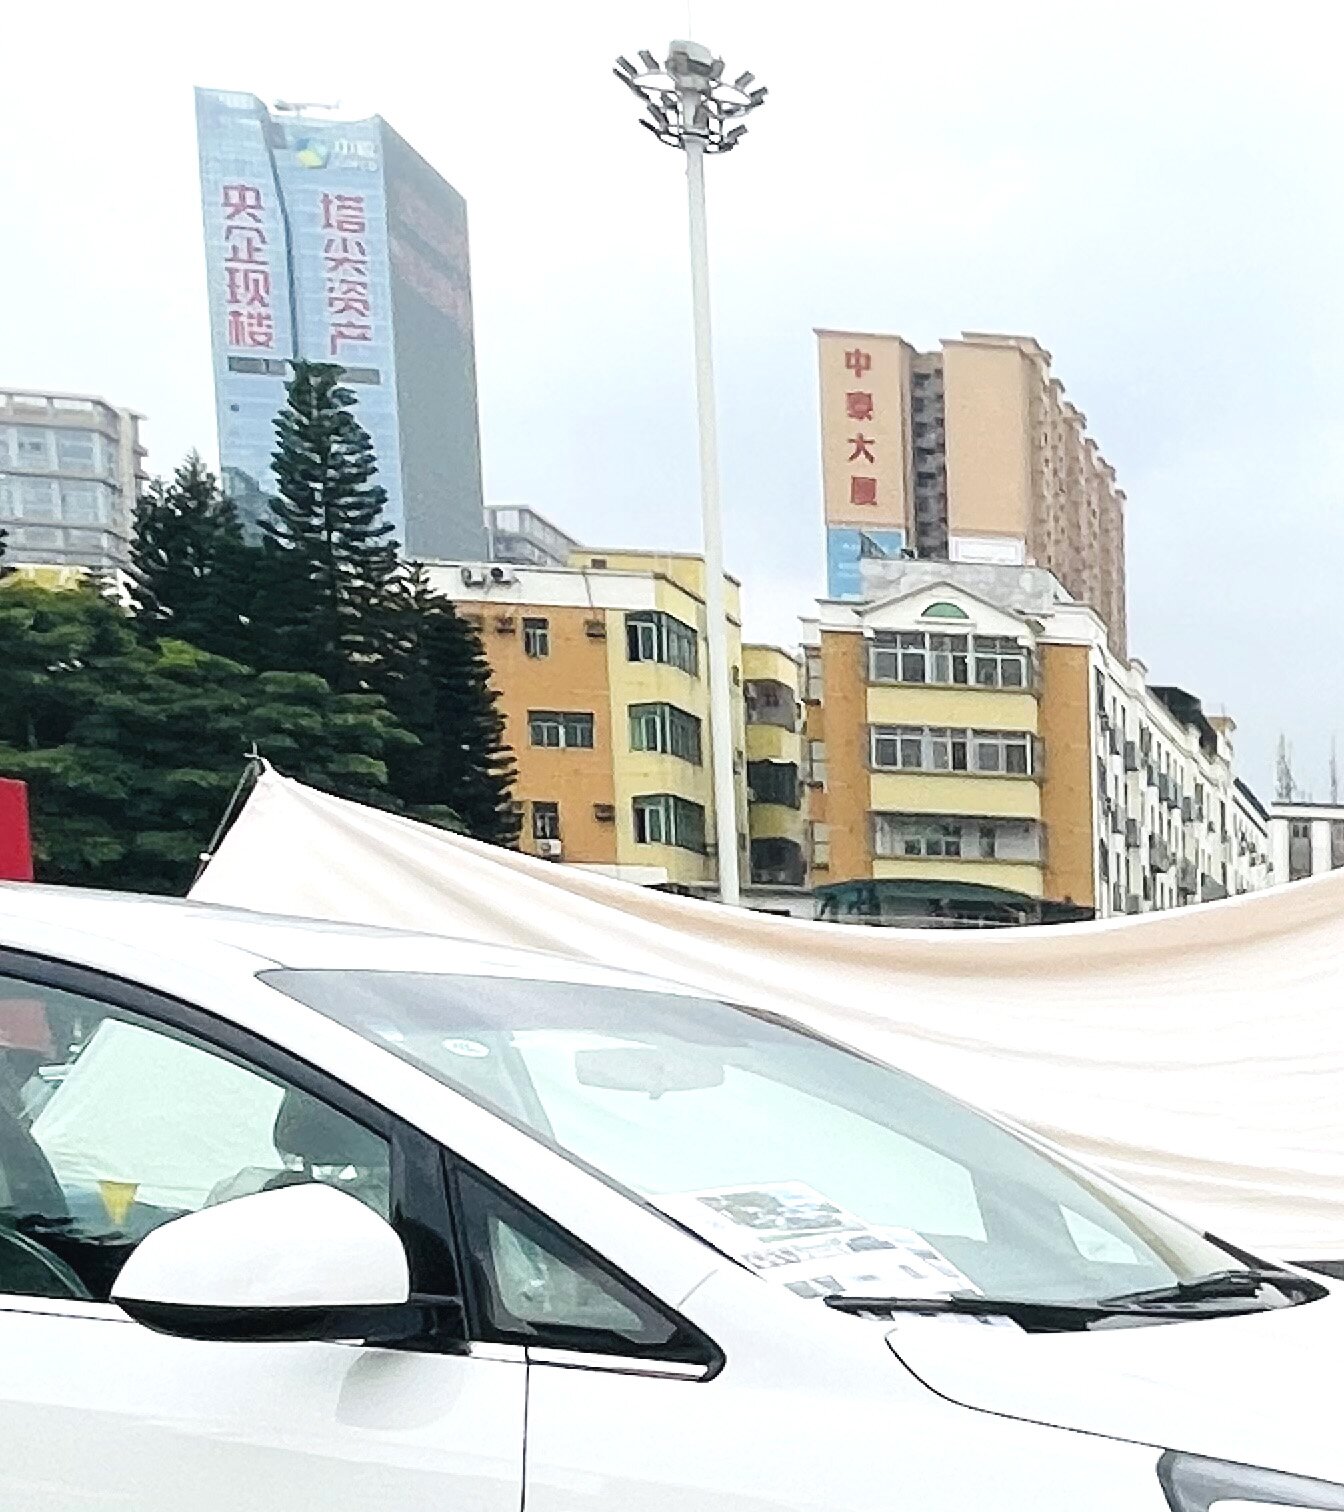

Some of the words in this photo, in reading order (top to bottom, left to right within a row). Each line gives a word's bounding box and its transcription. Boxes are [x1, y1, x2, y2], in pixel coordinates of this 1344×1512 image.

[221, 183, 273, 348] 央企现楼
[320, 192, 372, 355] 塔尖资产
